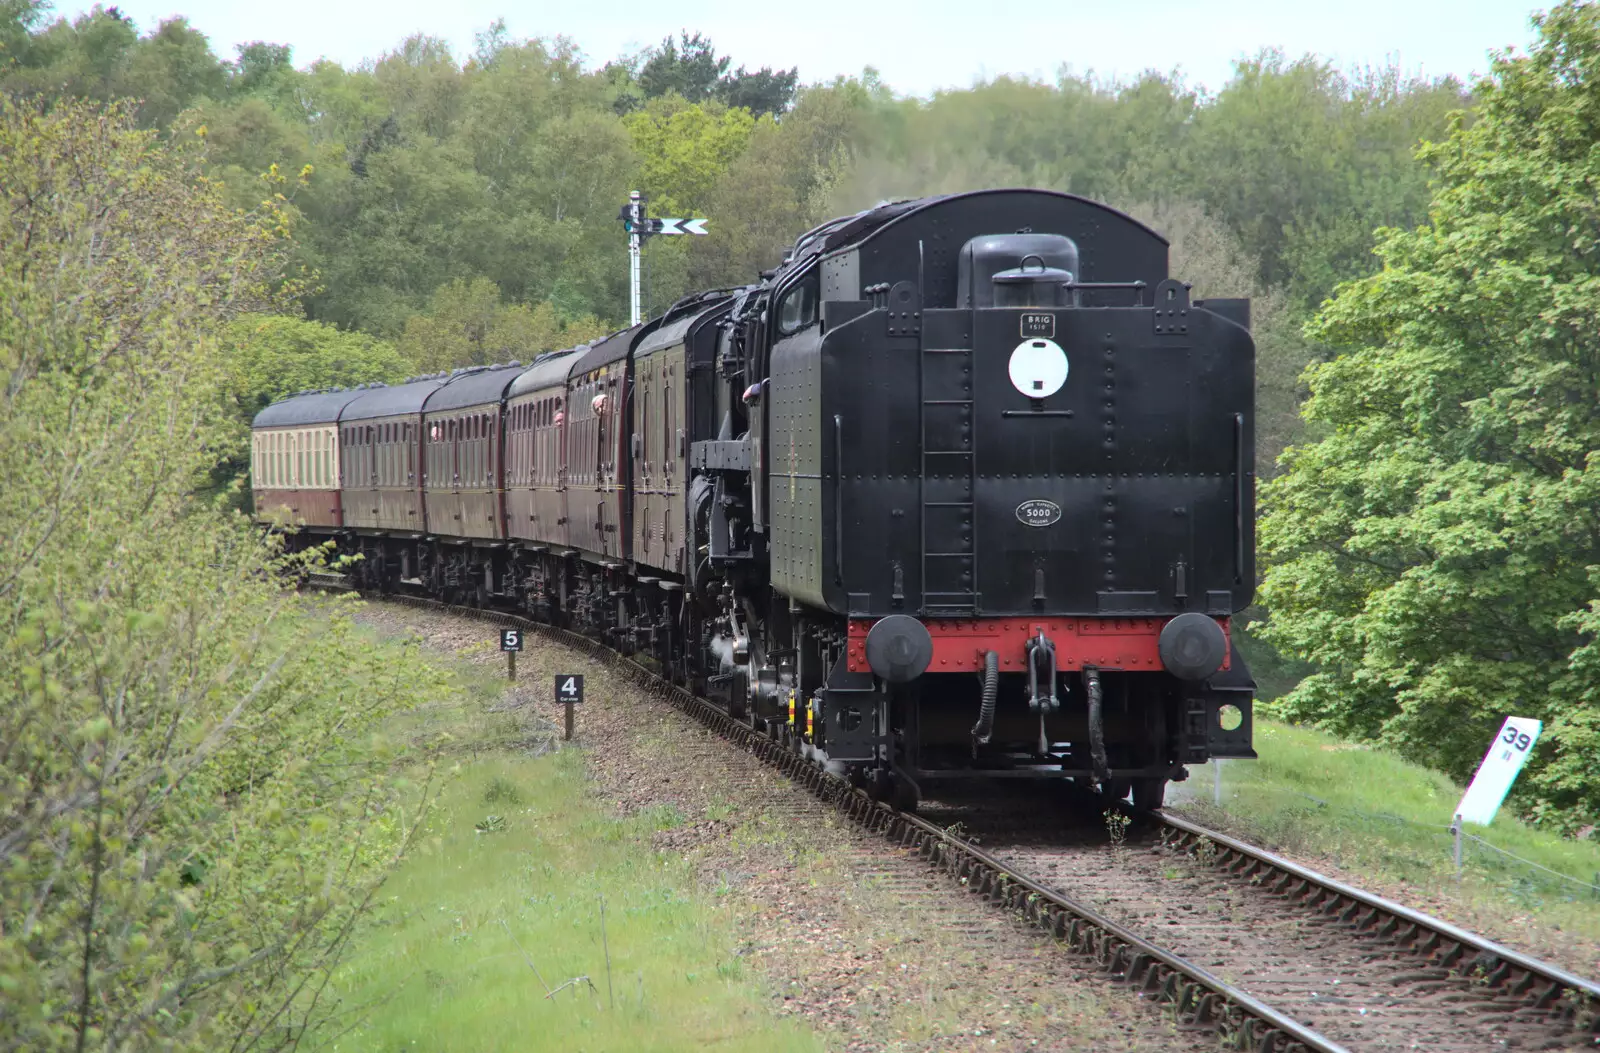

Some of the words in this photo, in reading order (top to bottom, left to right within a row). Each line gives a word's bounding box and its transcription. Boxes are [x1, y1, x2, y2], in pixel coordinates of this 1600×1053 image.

[1027, 509, 1050, 517] 5000
[505, 631, 518, 646] 5
[561, 677, 577, 695] 4
[1503, 726, 1531, 752] 39
